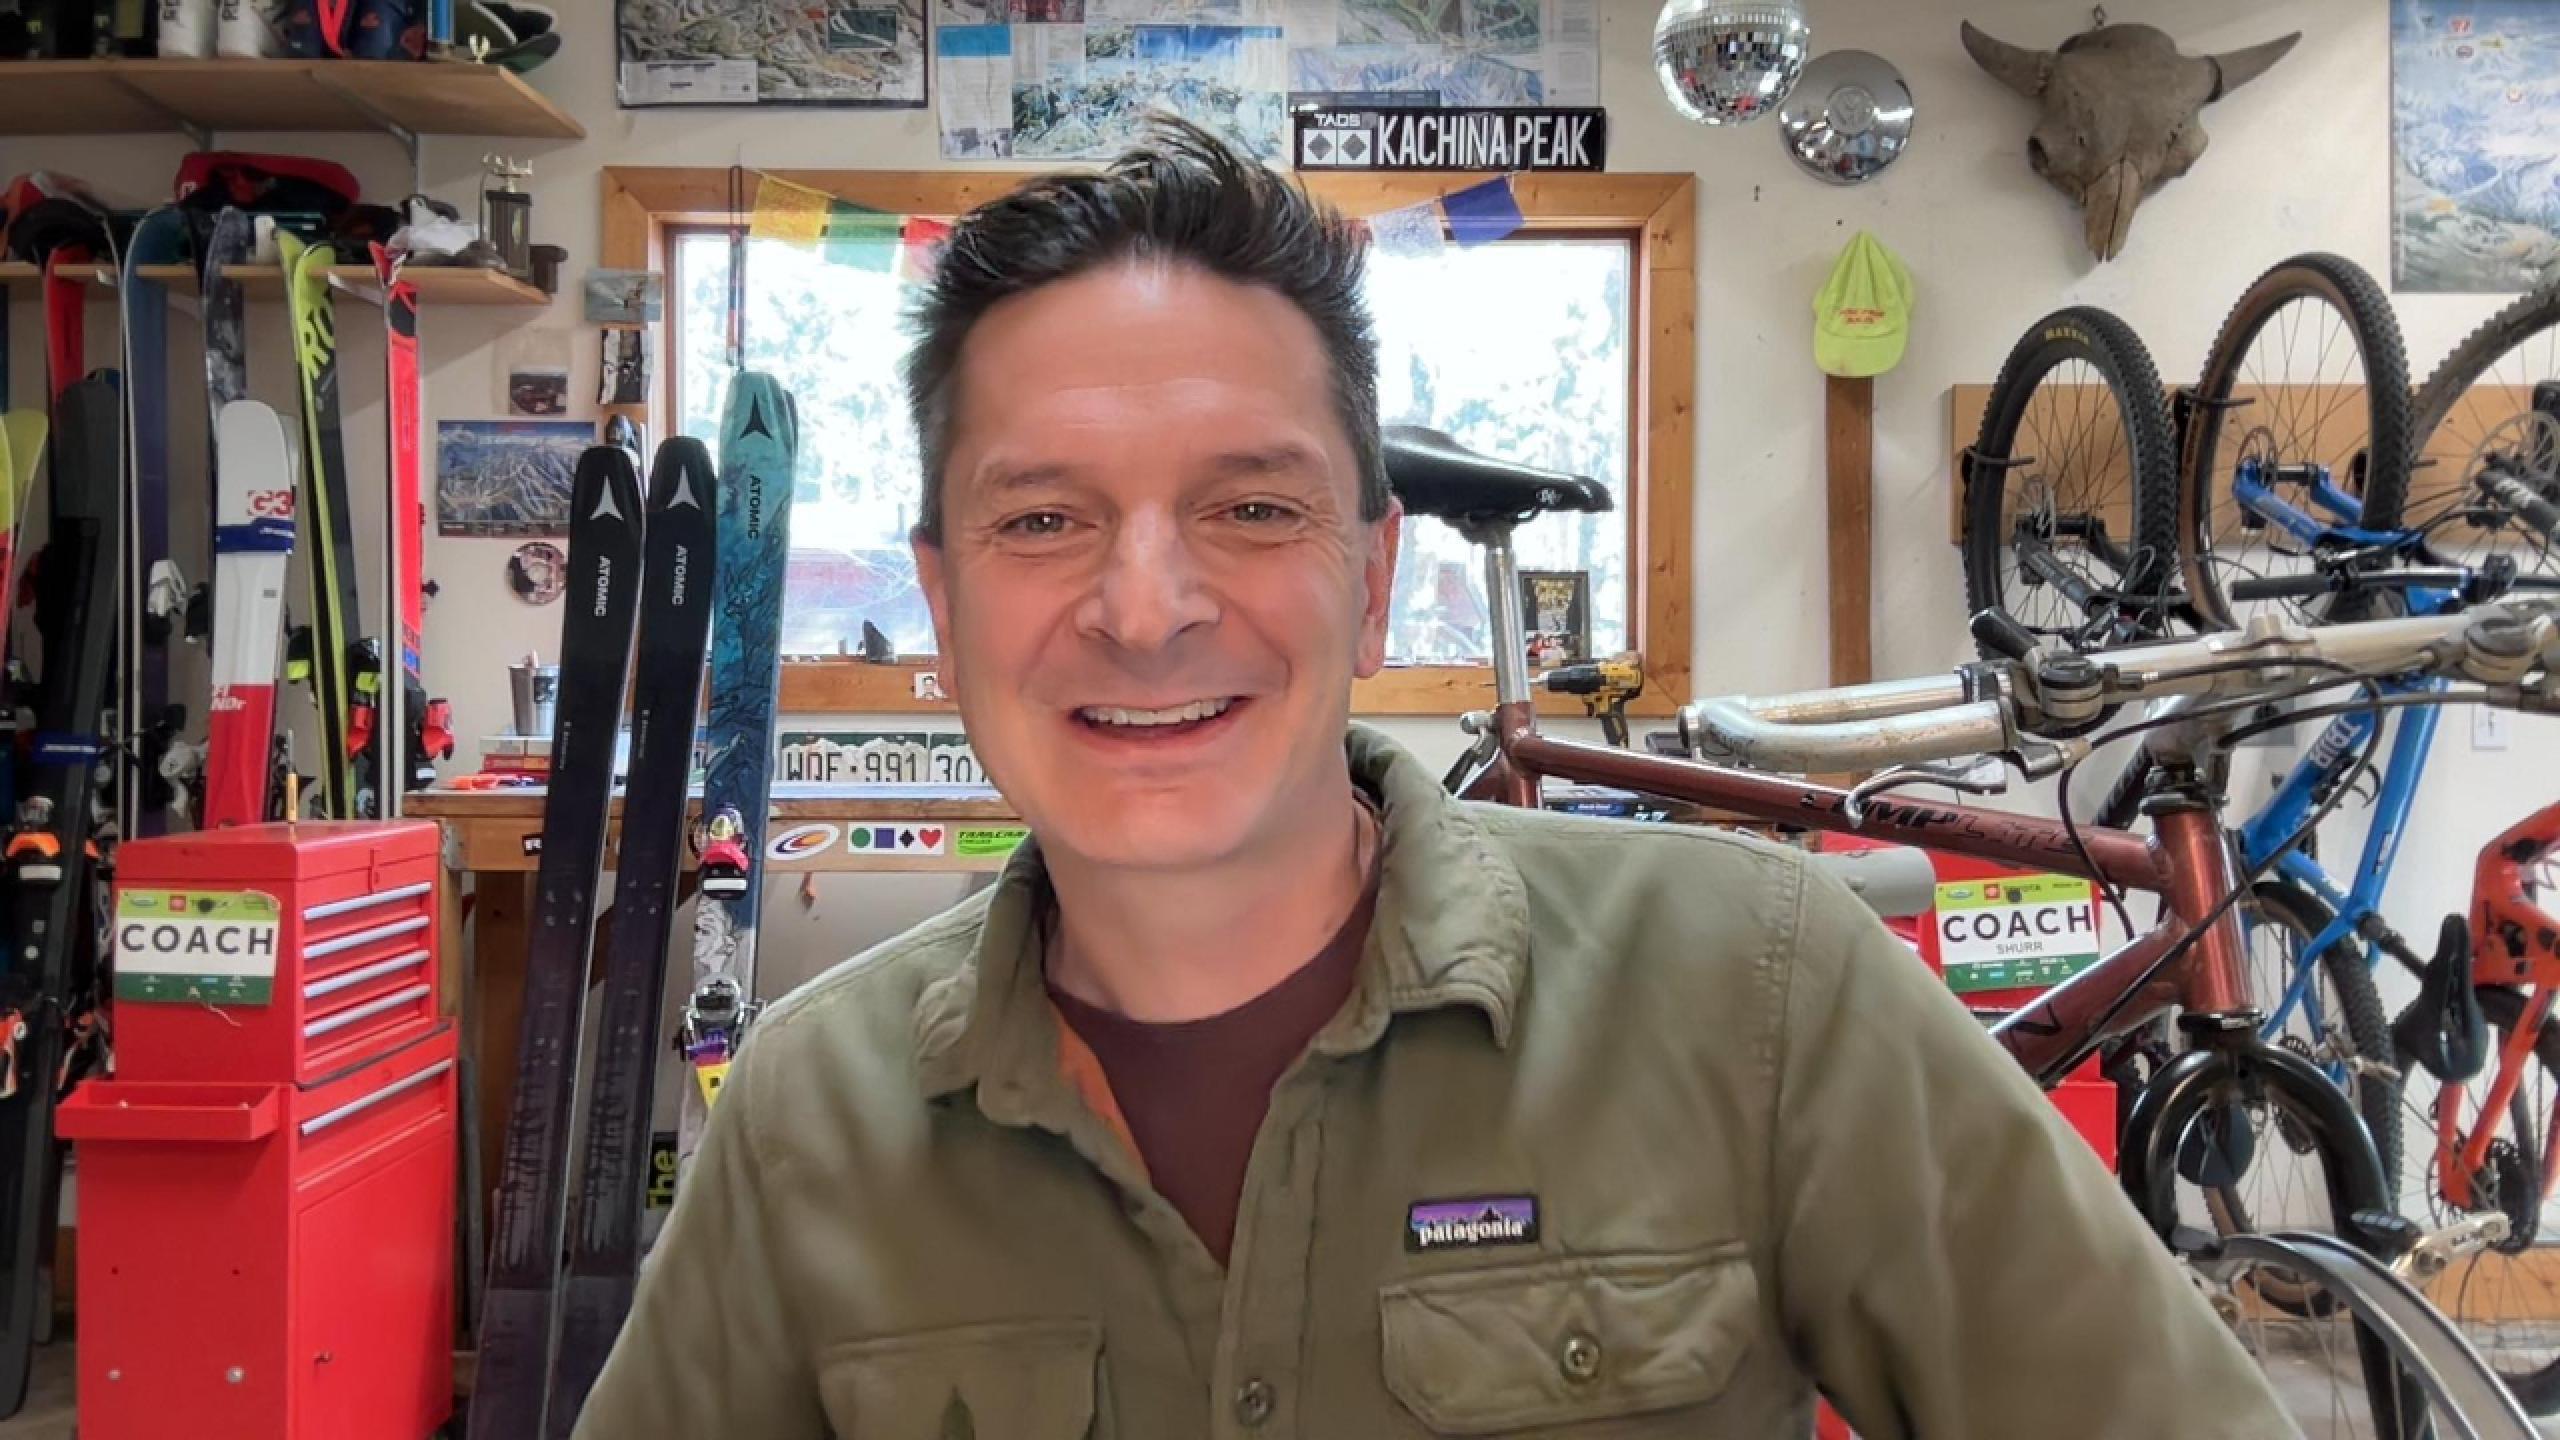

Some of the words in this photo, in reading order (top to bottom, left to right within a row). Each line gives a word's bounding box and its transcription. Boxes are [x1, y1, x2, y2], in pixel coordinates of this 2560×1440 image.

[1313, 113, 1361, 127] TAOS
[1377, 114, 1508, 166] KACHINA
[1513, 114, 1593, 166] PEAK
[747, 474, 761, 540] ATOMIC
[594, 555, 611, 617] ATOMIC
[671, 544, 688, 605] ATOMIC
[120, 923, 274, 955] COACH
[1943, 904, 2092, 943] COACH
[1996, 941, 2043, 955] SHURR
[1420, 1217, 1524, 1247] patagonia
